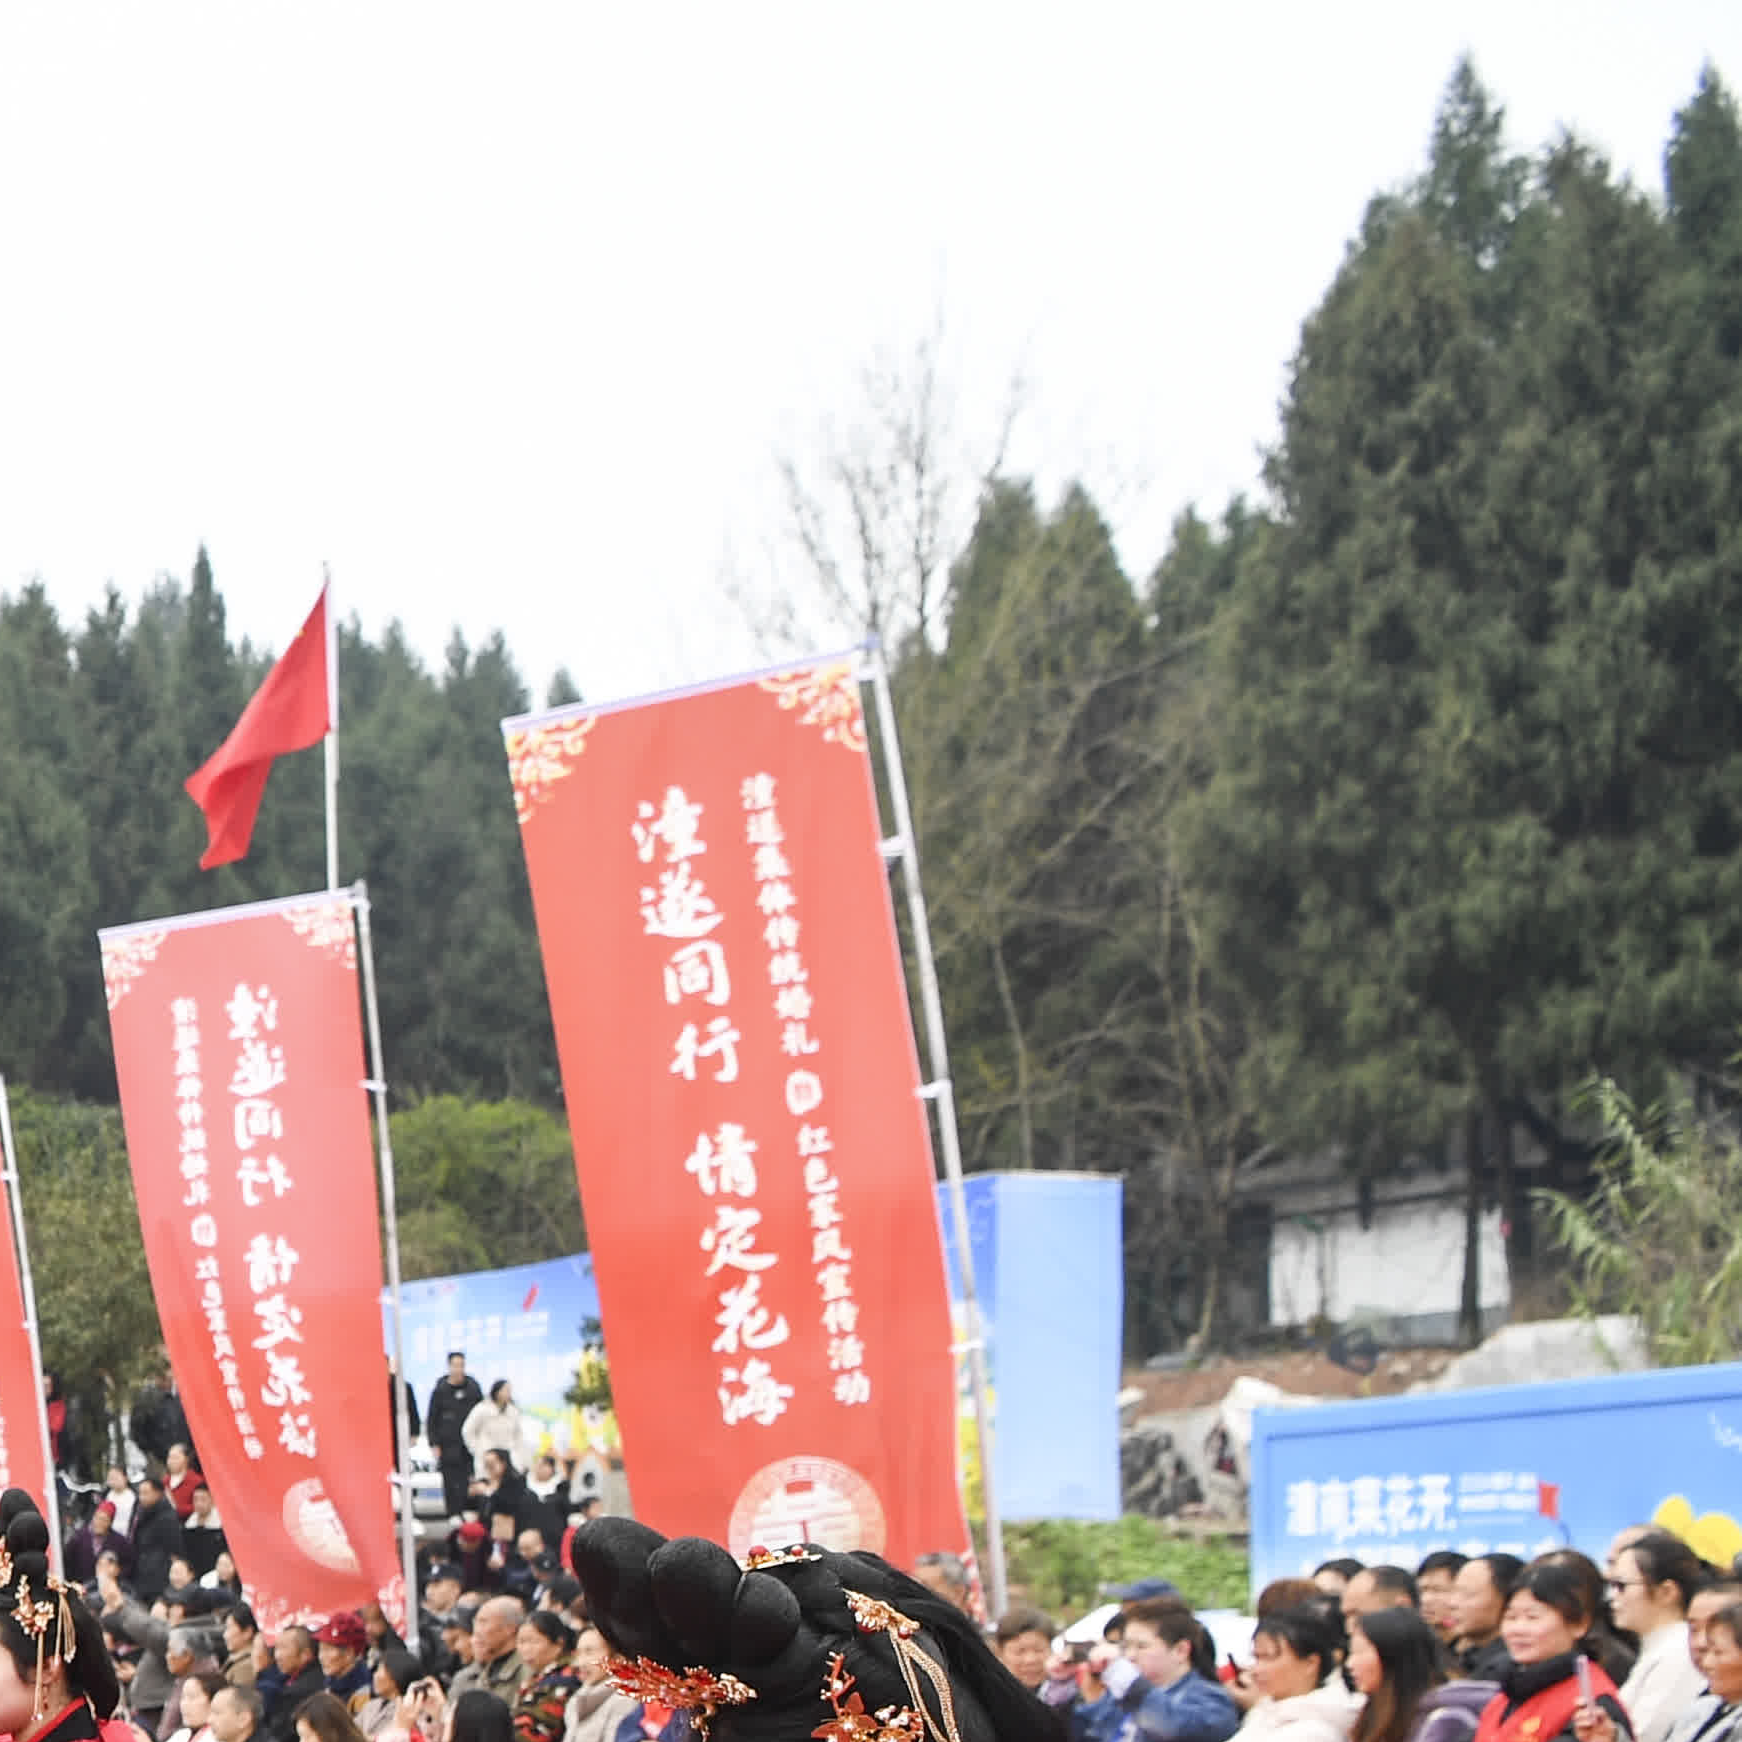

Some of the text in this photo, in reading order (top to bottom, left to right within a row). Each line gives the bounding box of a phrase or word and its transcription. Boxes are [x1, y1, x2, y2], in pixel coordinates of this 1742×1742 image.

[630, 785, 794, 1426] 潼遂同行 情定花海
[797, 1122, 871, 1405] 红色家风宣传活动
